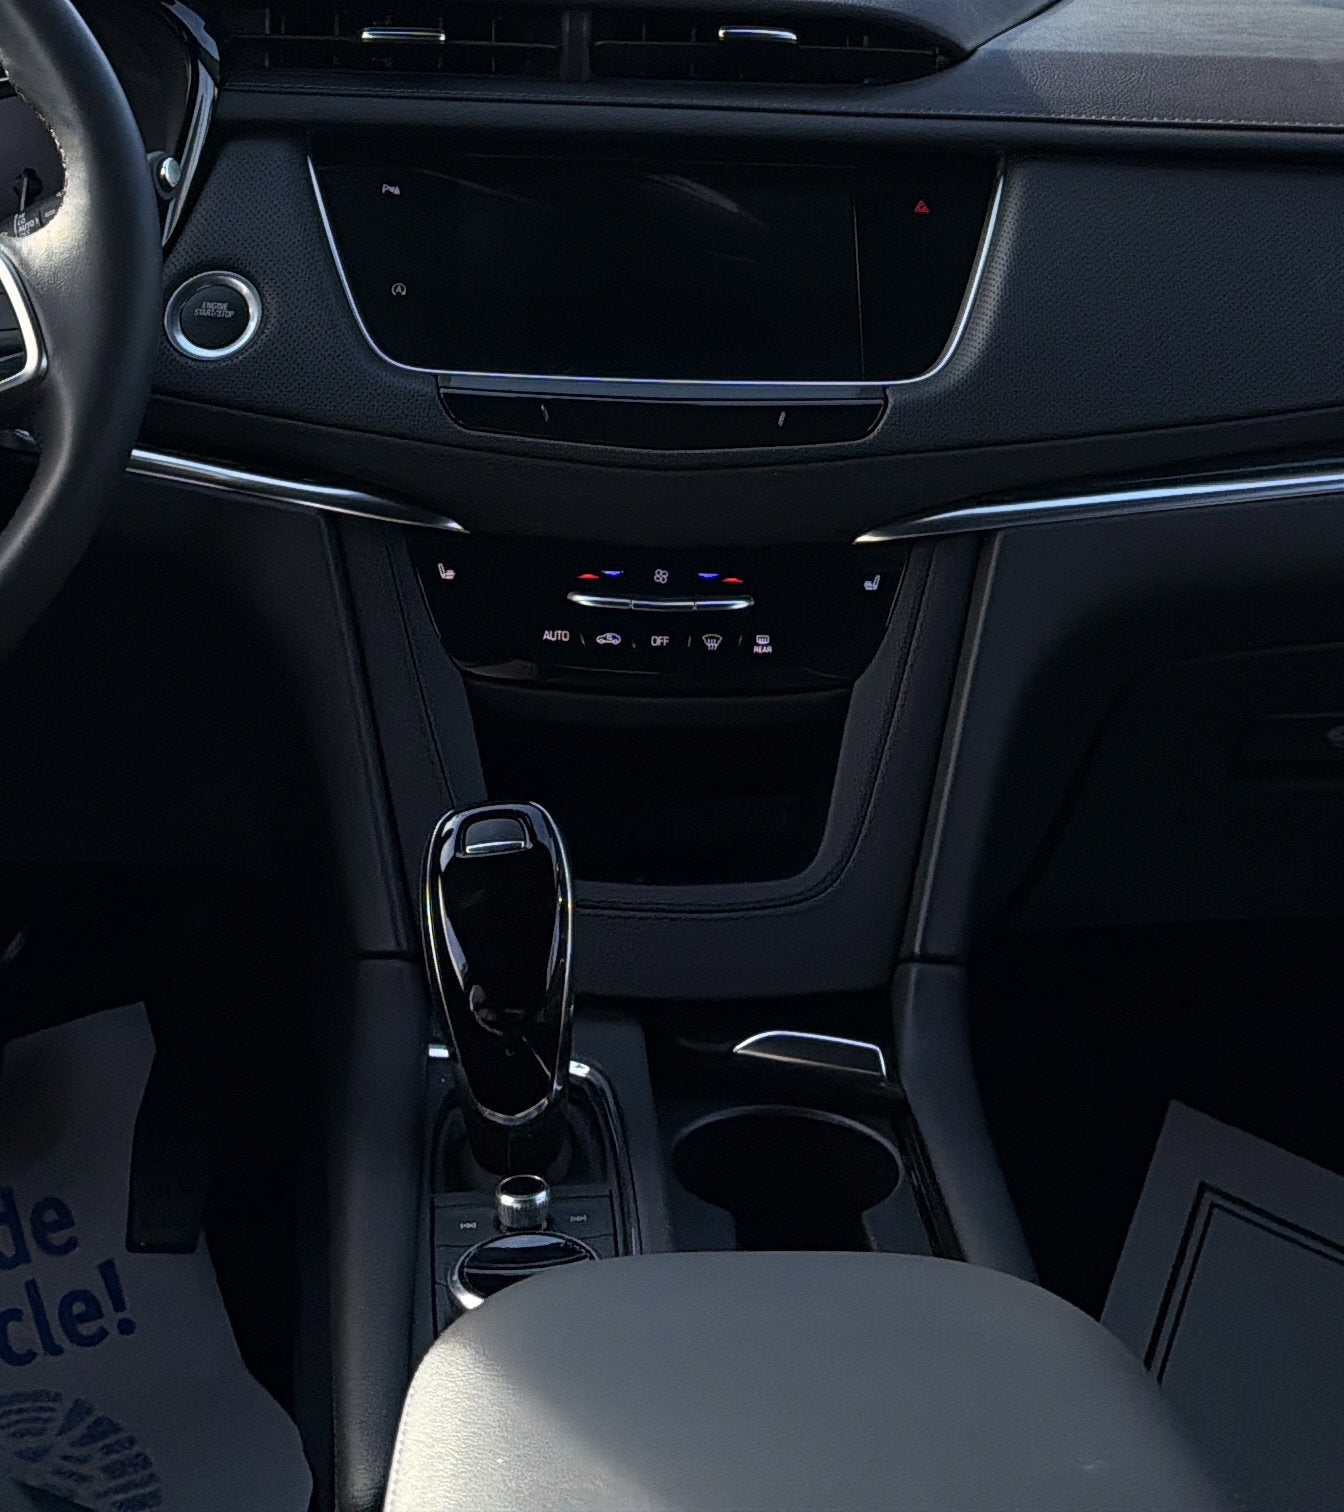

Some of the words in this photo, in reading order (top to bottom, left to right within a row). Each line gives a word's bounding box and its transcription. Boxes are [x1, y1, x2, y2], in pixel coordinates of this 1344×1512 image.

[202, 301, 230, 311] ENGINE
[194, 308, 235, 318] START/STOP
[543, 630, 570, 642] AUTO
[650, 635, 670, 647] OFF
[753, 645, 773, 655] REAR
